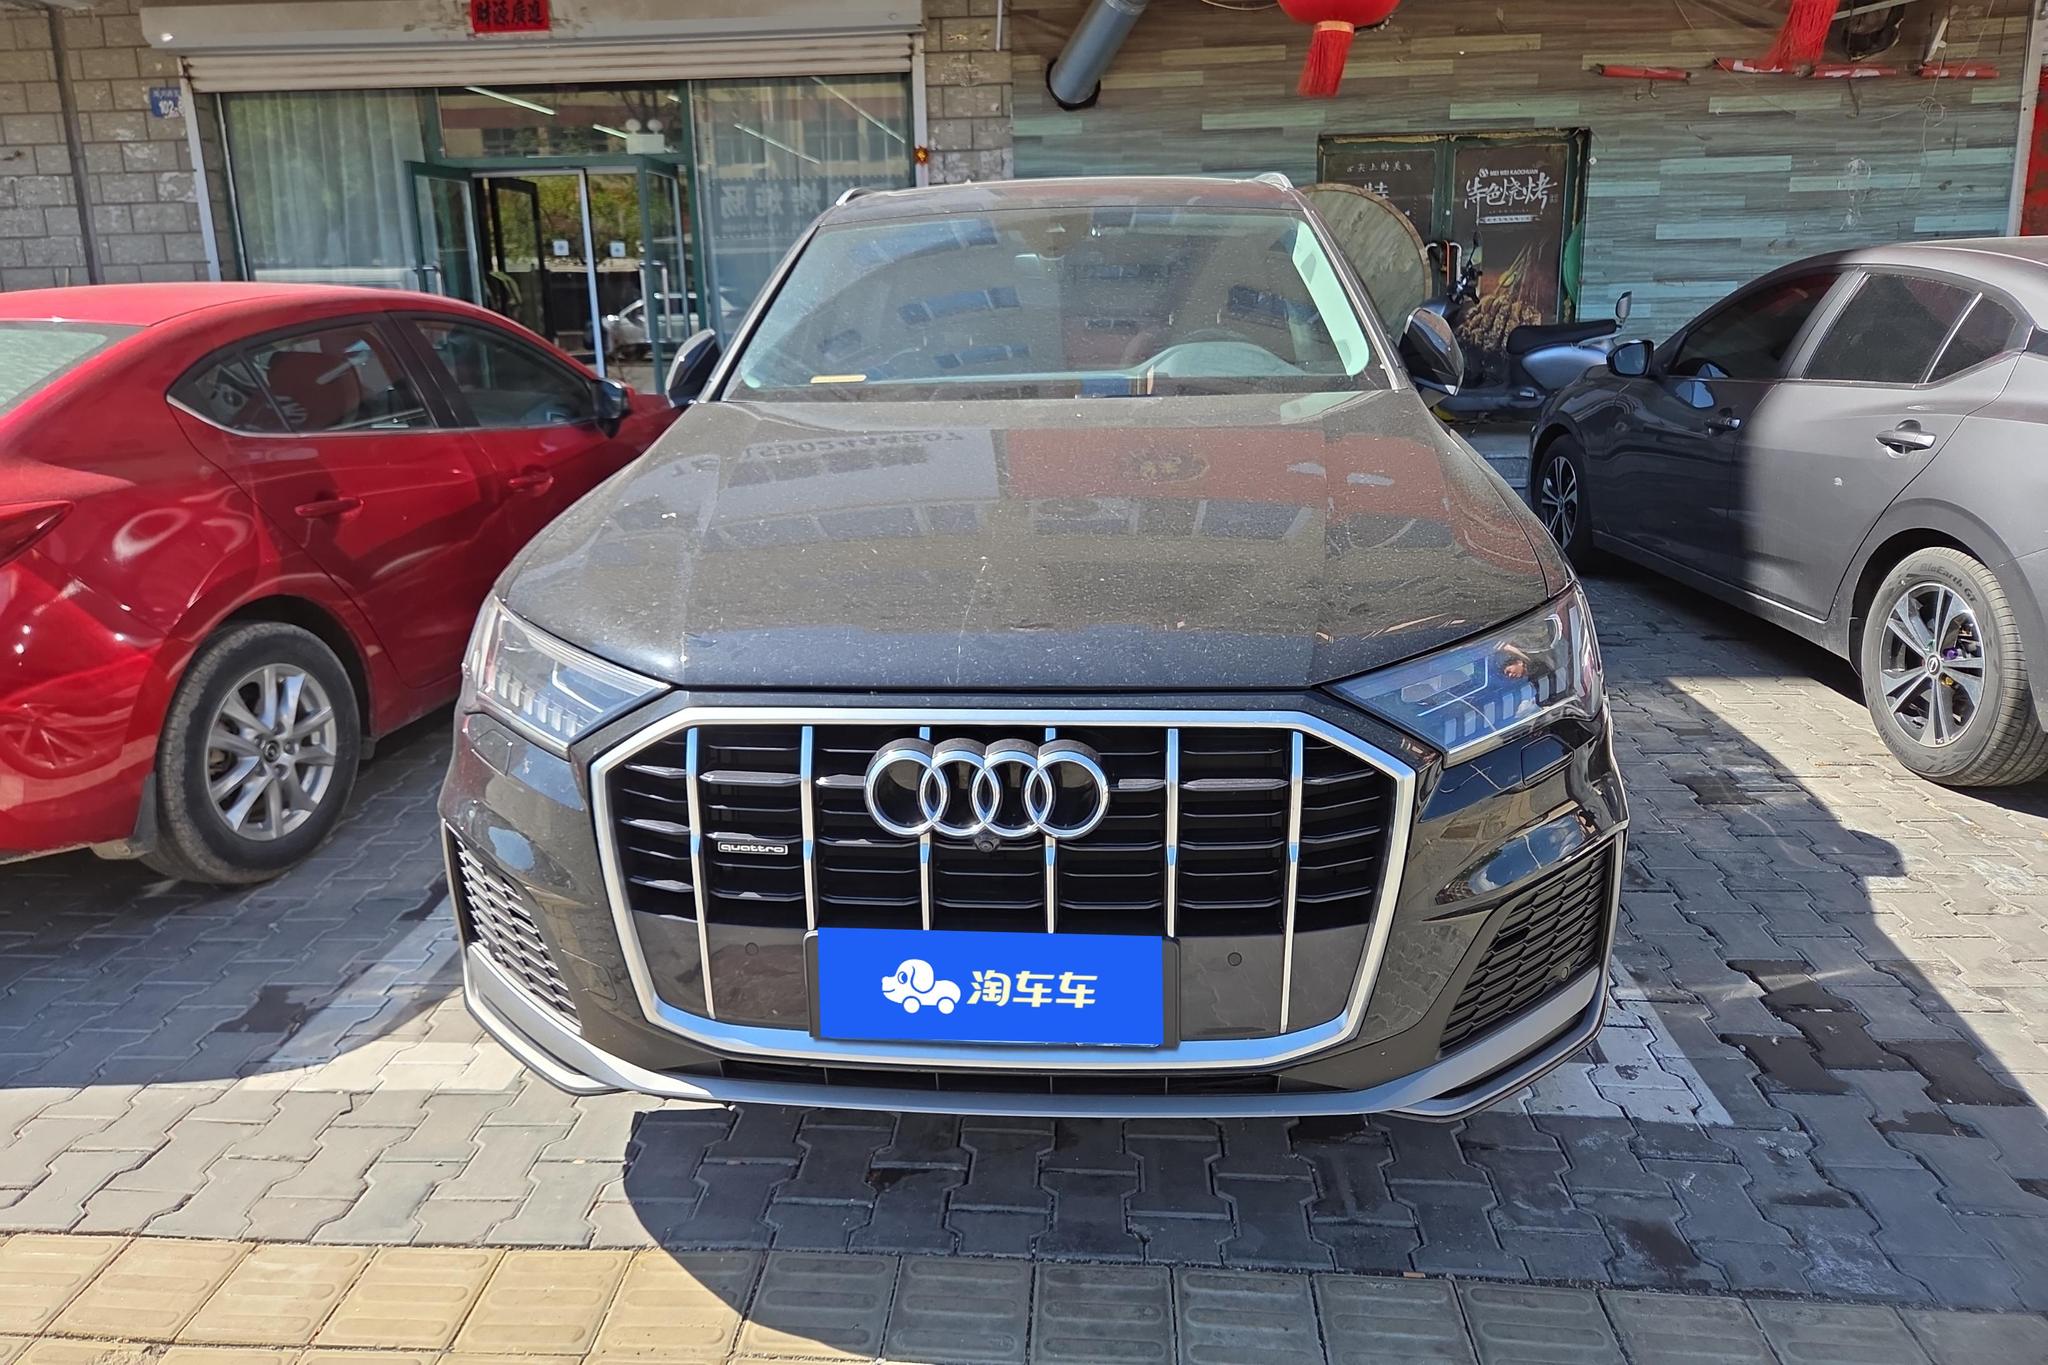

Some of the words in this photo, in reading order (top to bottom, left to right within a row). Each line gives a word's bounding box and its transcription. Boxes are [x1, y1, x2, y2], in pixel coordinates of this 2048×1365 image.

[1465, 172, 1557, 220] 特色烧烤
[720, 844, 784, 854] quattro
